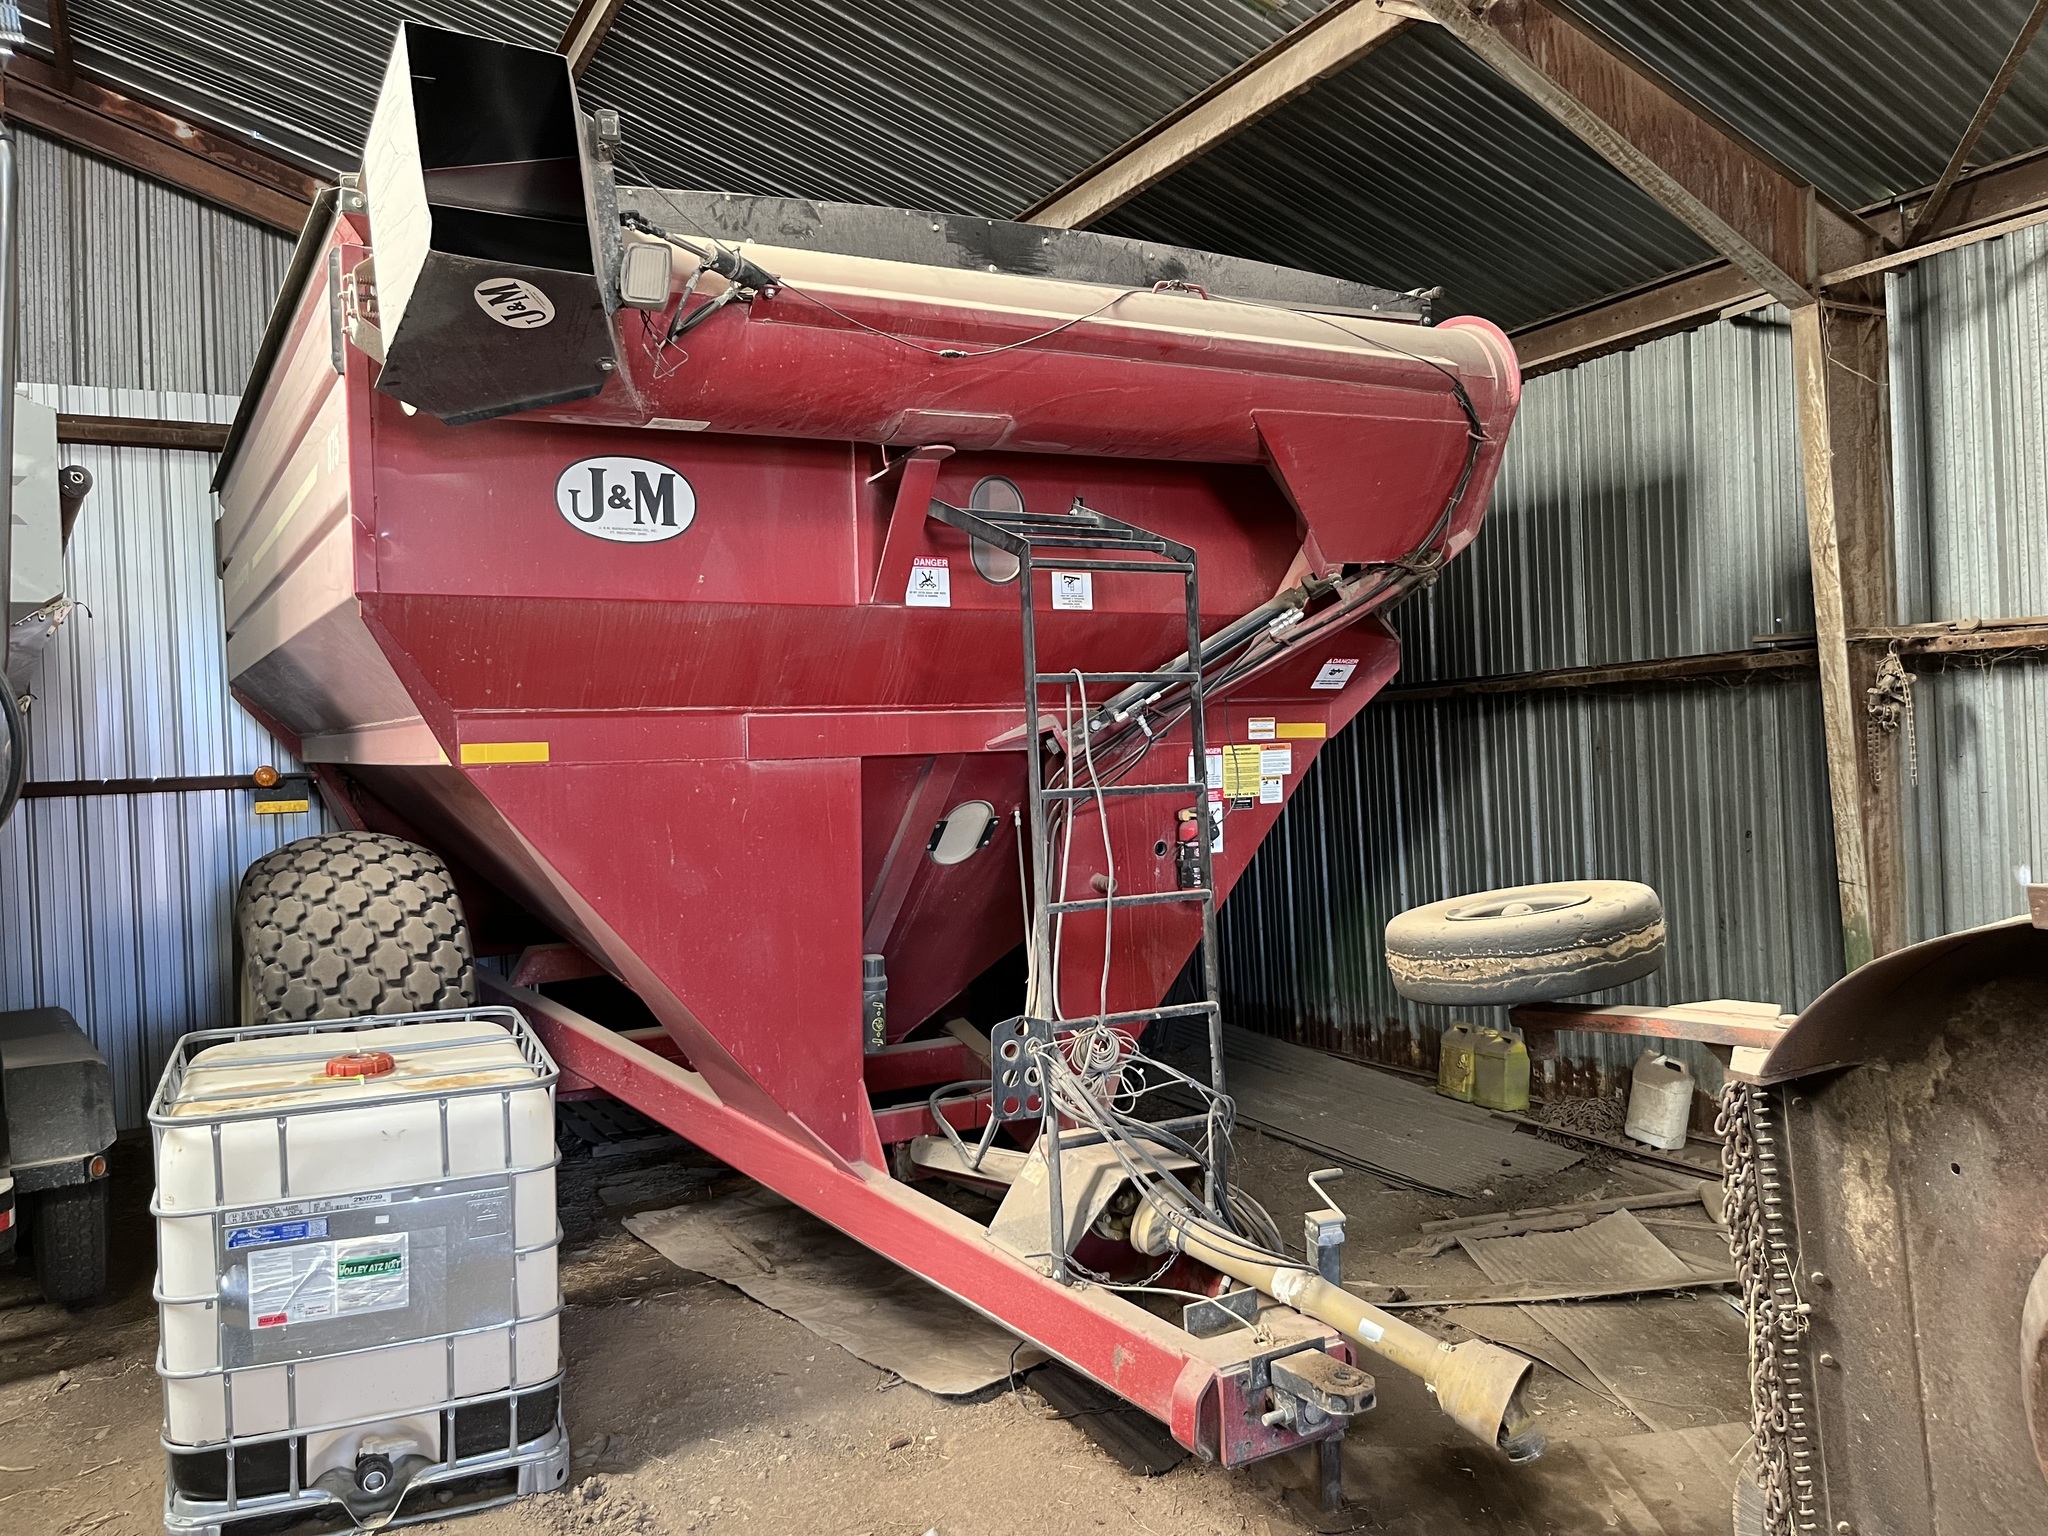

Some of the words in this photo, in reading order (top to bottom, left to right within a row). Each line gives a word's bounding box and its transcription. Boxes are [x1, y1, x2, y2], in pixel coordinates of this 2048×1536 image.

[477, 282, 546, 325] J&M
[568, 467, 678, 527] J&M
[913, 557, 949, 567] DANGER
[338, 1263, 369, 1277] VOLLEY
[369, 1261, 384, 1273] ATZ
